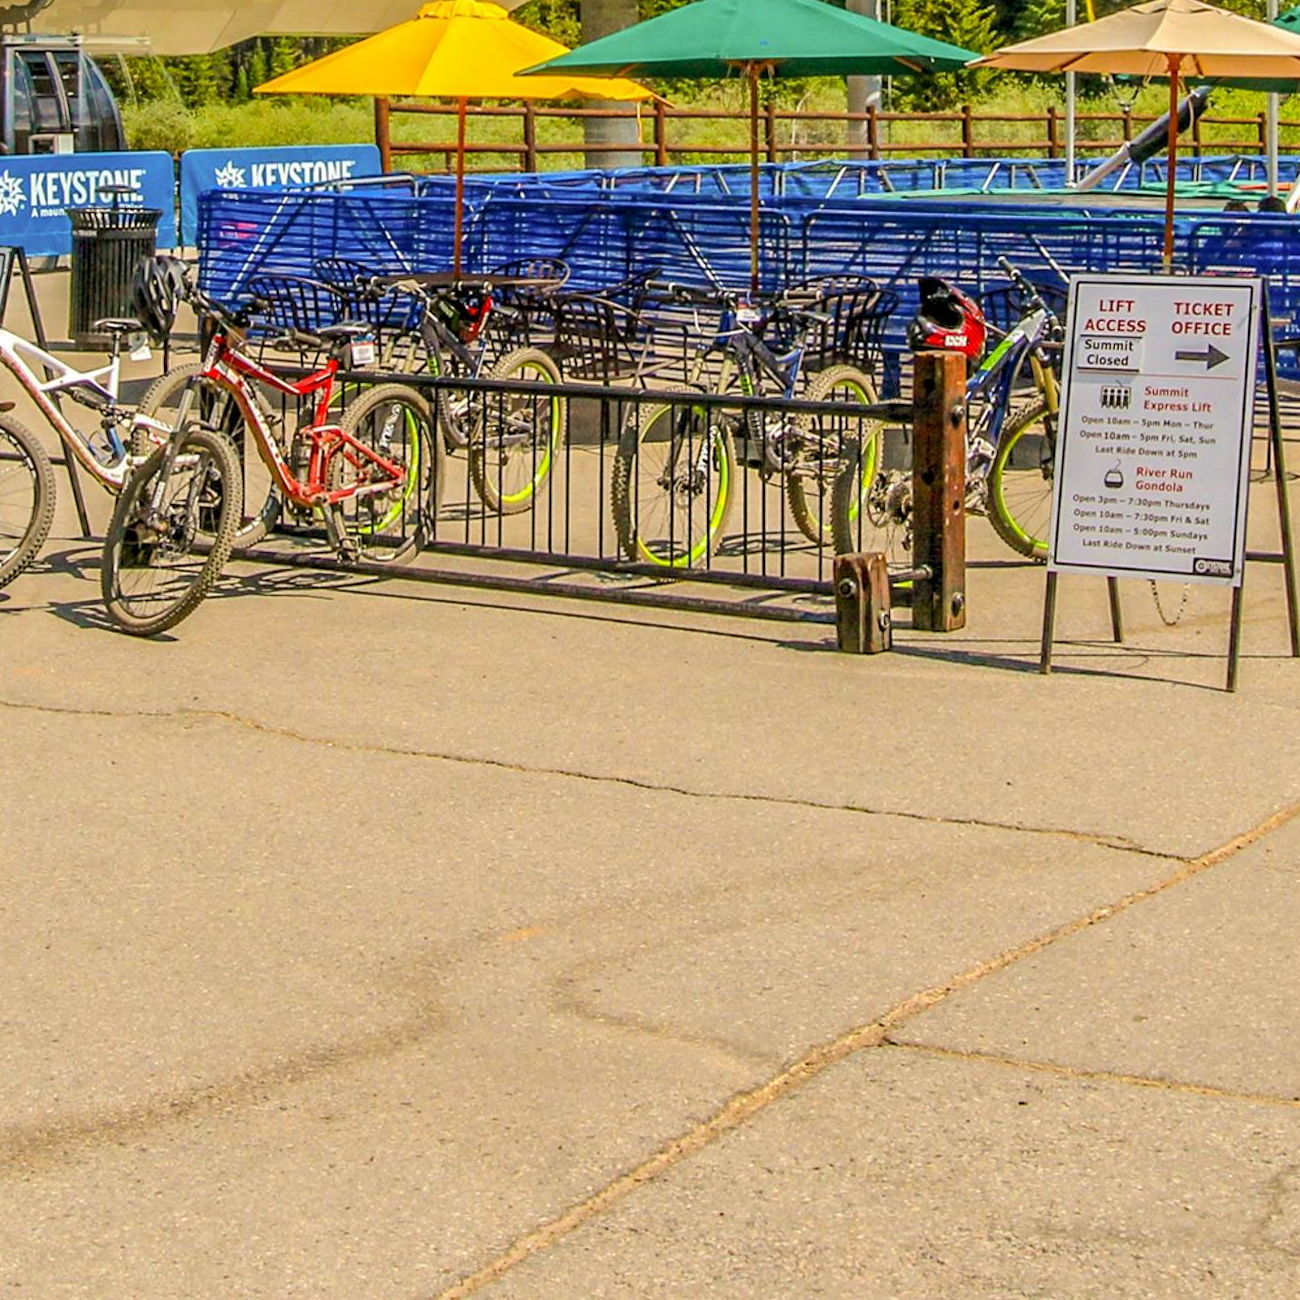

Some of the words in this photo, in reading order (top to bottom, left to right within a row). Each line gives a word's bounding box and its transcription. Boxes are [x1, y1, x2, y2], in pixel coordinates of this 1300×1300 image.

[251, 161, 353, 193] KEYSTONE
[30, 169, 143, 206] KEYSTONE
[31, 208, 38, 218] A
[1100, 300, 1135, 313] LIFT
[1174, 302, 1234, 317] TICKET
[1085, 319, 1146, 333] ACCESS
[1171, 321, 1232, 336] OFFICE
[1085, 339, 1133, 351] Summit
[1087, 354, 1129, 366] Closed
[1144, 387, 1189, 397] Summit
[1144, 400, 1188, 412] Express
[1192, 403, 1212, 413] Lift
[1081, 415, 1104, 425] Open
[1107, 416, 1131, 425] 10am
[1141, 418, 1160, 428] 5pm
[1163, 419, 1182, 427] Mon
[1193, 421, 1213, 429] Thur
[1080, 430, 1102, 440] Open
[1104, 431, 1130, 440] 10am
[1140, 433, 1159, 443] 5pm
[1198, 436, 1216, 444] Sun
[1095, 445, 1114, 454] Last
[1116, 446, 1136, 455] Ride
[1138, 447, 1164, 457] Down
[1166, 448, 1175, 457] at
[1178, 449, 1197, 460] 5pm
[1136, 466, 1166, 478] River
[1170, 468, 1193, 479] Run
[1135, 480, 1183, 492] Gondola
[1073, 493, 1096, 503] Open
[1098, 495, 1117, 504] 3pm
[1128, 497, 1161, 507] 7:30pm
[1164, 499, 1210, 511] Thursdays
[1074, 508, 1097, 518] Open
[1099, 510, 1123, 519] 10am
[1134, 512, 1168, 523] 7:30pm
[1170, 515, 1182, 523] Fri
[1184, 516, 1192, 524] &
[1194, 517, 1210, 526] Sat
[1073, 523, 1096, 533] Open
[1098, 525, 1123, 534] 10am
[1134, 527, 1167, 538] 5:00pm
[1170, 530, 1208, 542] Sundays
[1082, 539, 1101, 547] Last
[1103, 540, 1123, 549] Ride
[1125, 541, 1151, 551] Down
[1153, 543, 1162, 552] at
[1165, 544, 1196, 554] Sunset
